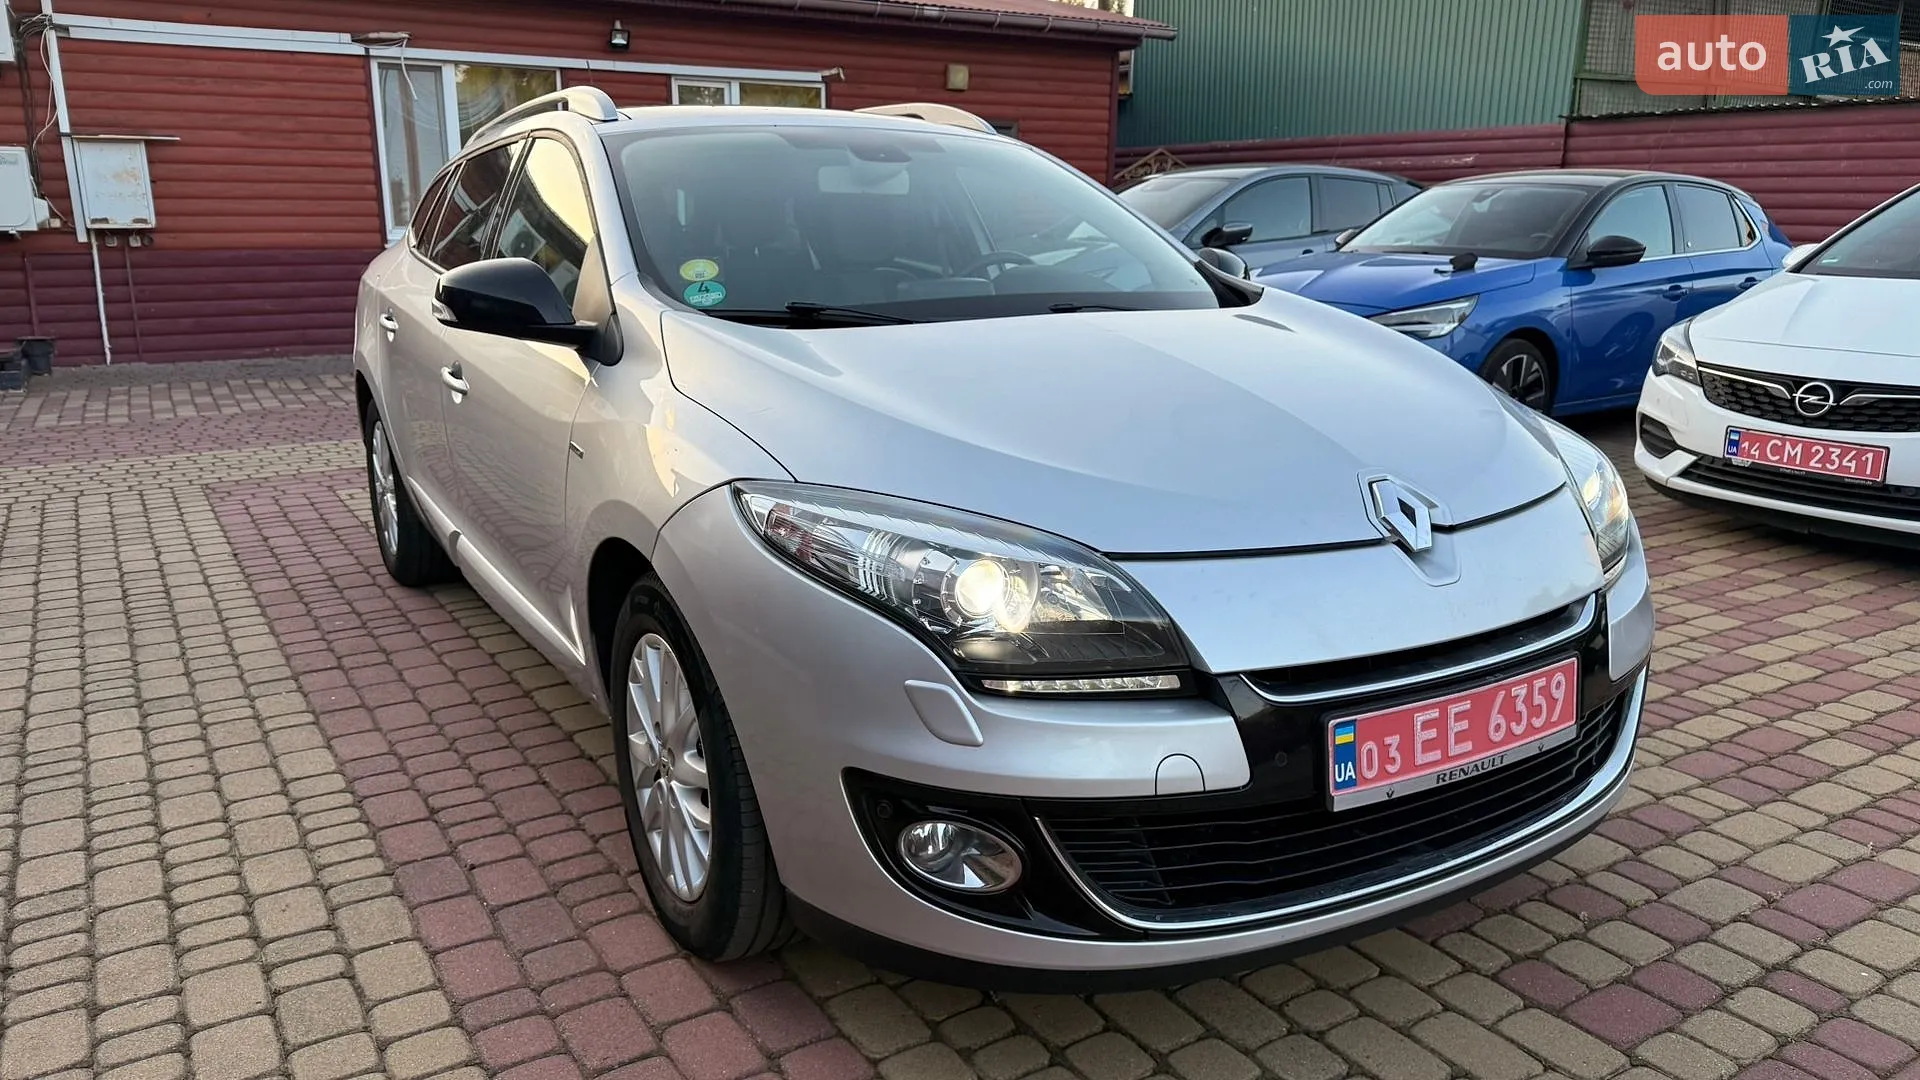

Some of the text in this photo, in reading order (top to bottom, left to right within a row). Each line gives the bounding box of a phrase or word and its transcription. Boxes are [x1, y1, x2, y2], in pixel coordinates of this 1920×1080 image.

[697, 282, 711, 294] 4
[1728, 445, 1737, 454] UA
[1741, 439, 1874, 475] 14 CM 2341
[1360, 671, 1566, 779] 03 EE 6359
[1334, 761, 1356, 783] UA
[1436, 754, 1508, 785] RENAULT
